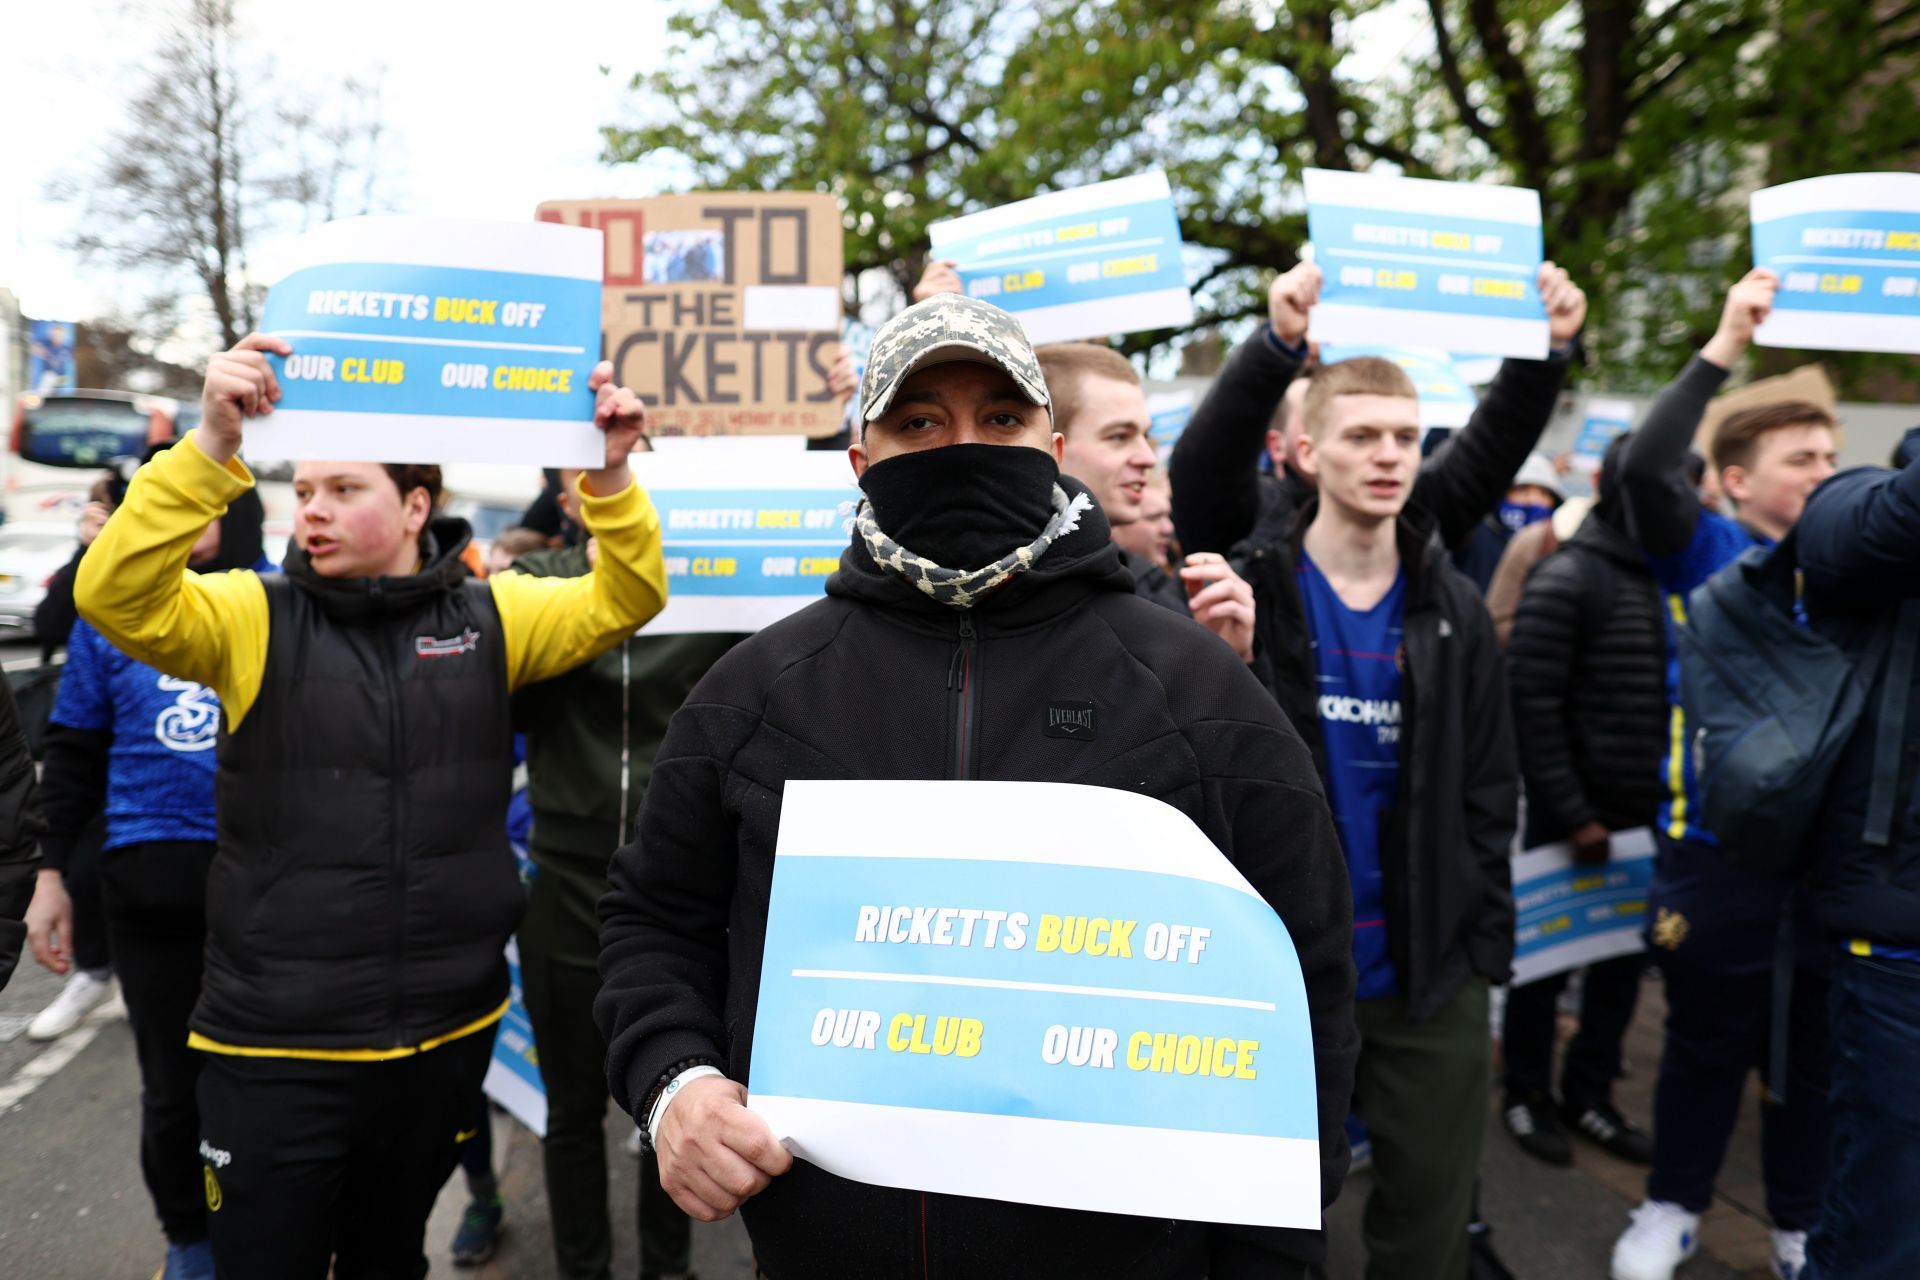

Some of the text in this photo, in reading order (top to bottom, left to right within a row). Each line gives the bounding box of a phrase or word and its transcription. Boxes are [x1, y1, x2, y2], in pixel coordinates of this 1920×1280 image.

[703, 207, 809, 285] TO
[306, 290, 546, 328] RICKETTS BUCK OFF
[625, 293, 736, 326] THE
[284, 354, 405, 384] OUR CLUB
[441, 363, 574, 393] OUR CHOICE
[602, 331, 841, 406] CKETTS
[669, 509, 753, 528] RICKETTS
[804, 510, 836, 528] OFF
[665, 556, 737, 576] UR CLUB
[762, 557, 796, 576] OUR
[1049, 707, 1092, 729] EVERLAST
[854, 905, 1212, 964] RICKETTS BUCK OFF
[811, 1008, 984, 1058] OUR CLUB
[1041, 1024, 1260, 1080] OUR CHOICE
